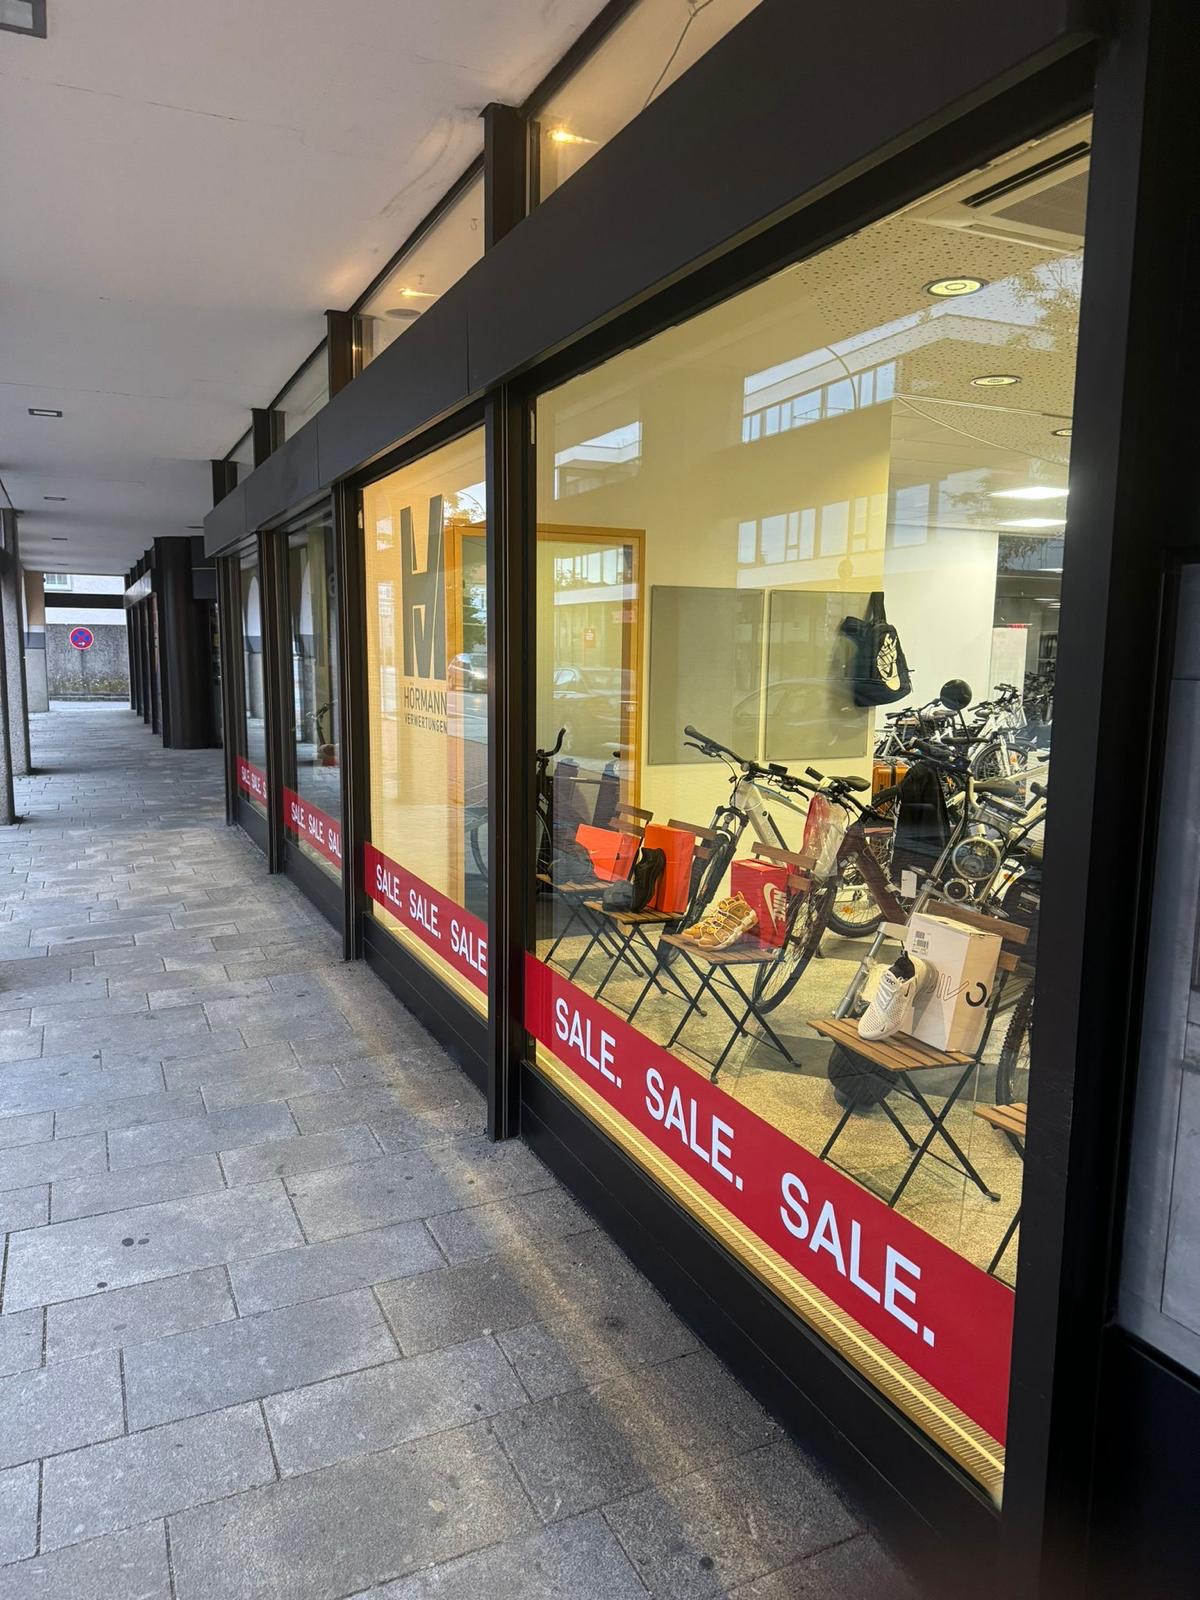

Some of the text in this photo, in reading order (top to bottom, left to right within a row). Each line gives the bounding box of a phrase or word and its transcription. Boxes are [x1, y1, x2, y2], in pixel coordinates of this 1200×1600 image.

[404, 682, 448, 715] HÖRMANN
[404, 712, 448, 734] VERWERTUNGEN
[328, 829, 342, 859] SAL
[376, 864, 403, 907] SALE.
[409, 889, 441, 939] SALE.
[773, 889, 787, 922] NIKE
[554, 998, 935, 1347] SALE. SALE. SALE.
